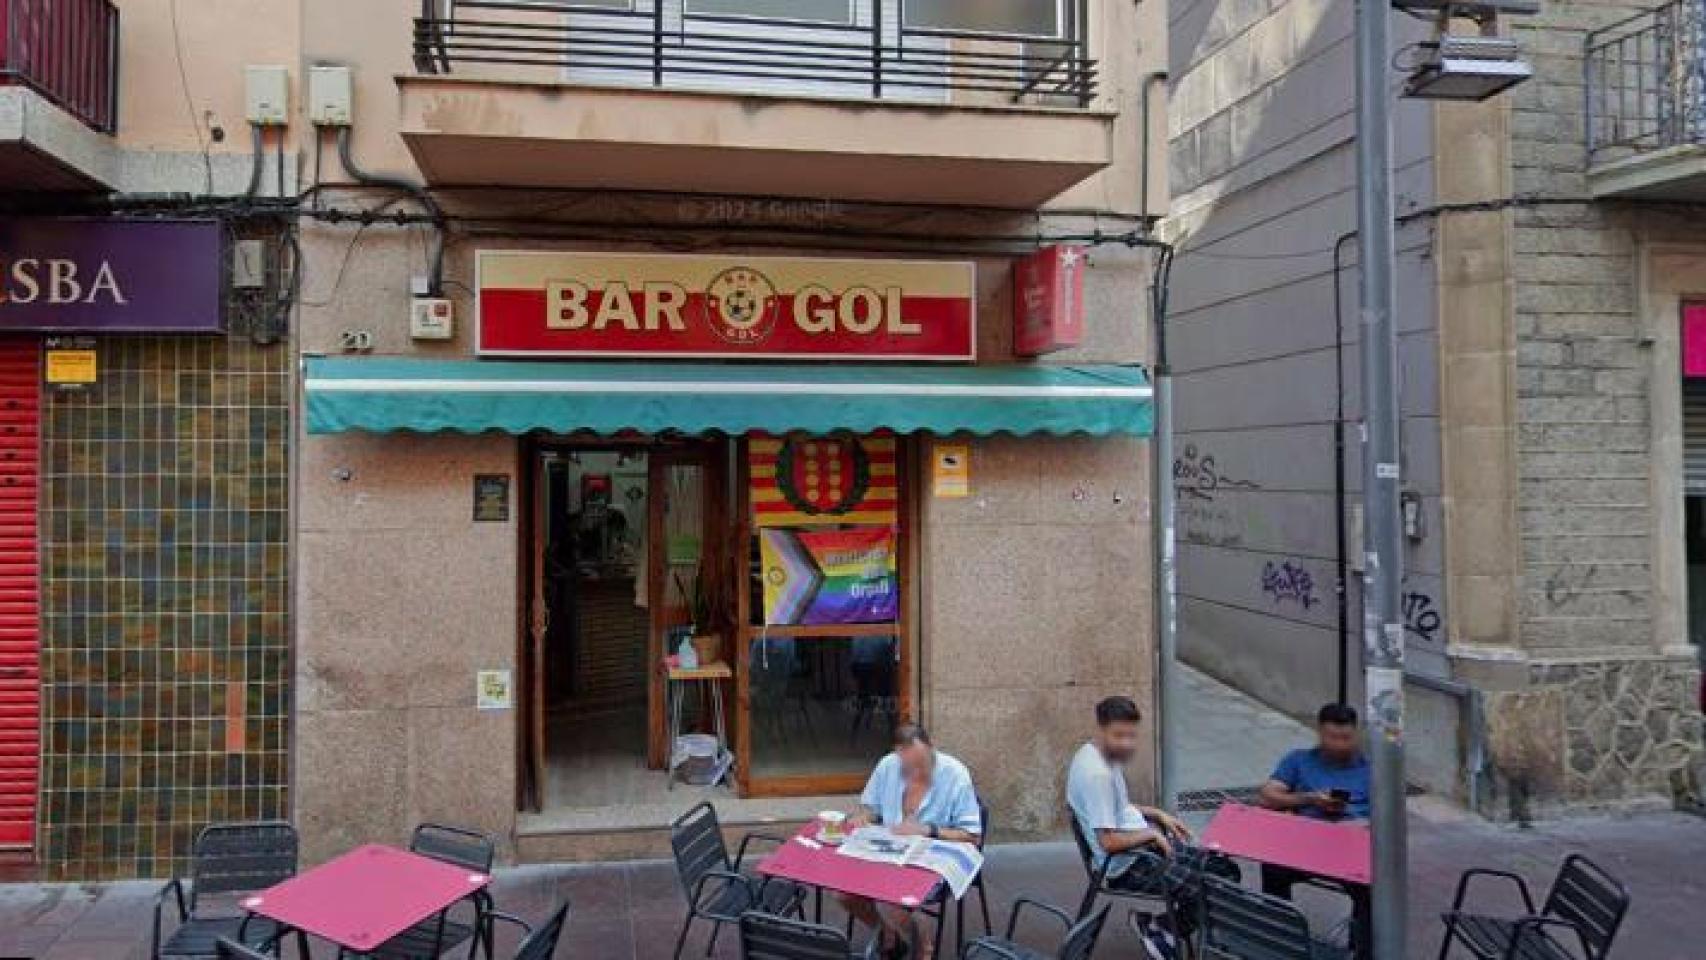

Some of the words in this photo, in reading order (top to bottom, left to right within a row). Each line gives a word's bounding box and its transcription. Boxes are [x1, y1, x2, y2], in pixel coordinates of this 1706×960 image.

[0, 258, 127, 304] SBA
[546, 281, 687, 330] BAR
[793, 284, 922, 334] GOL
